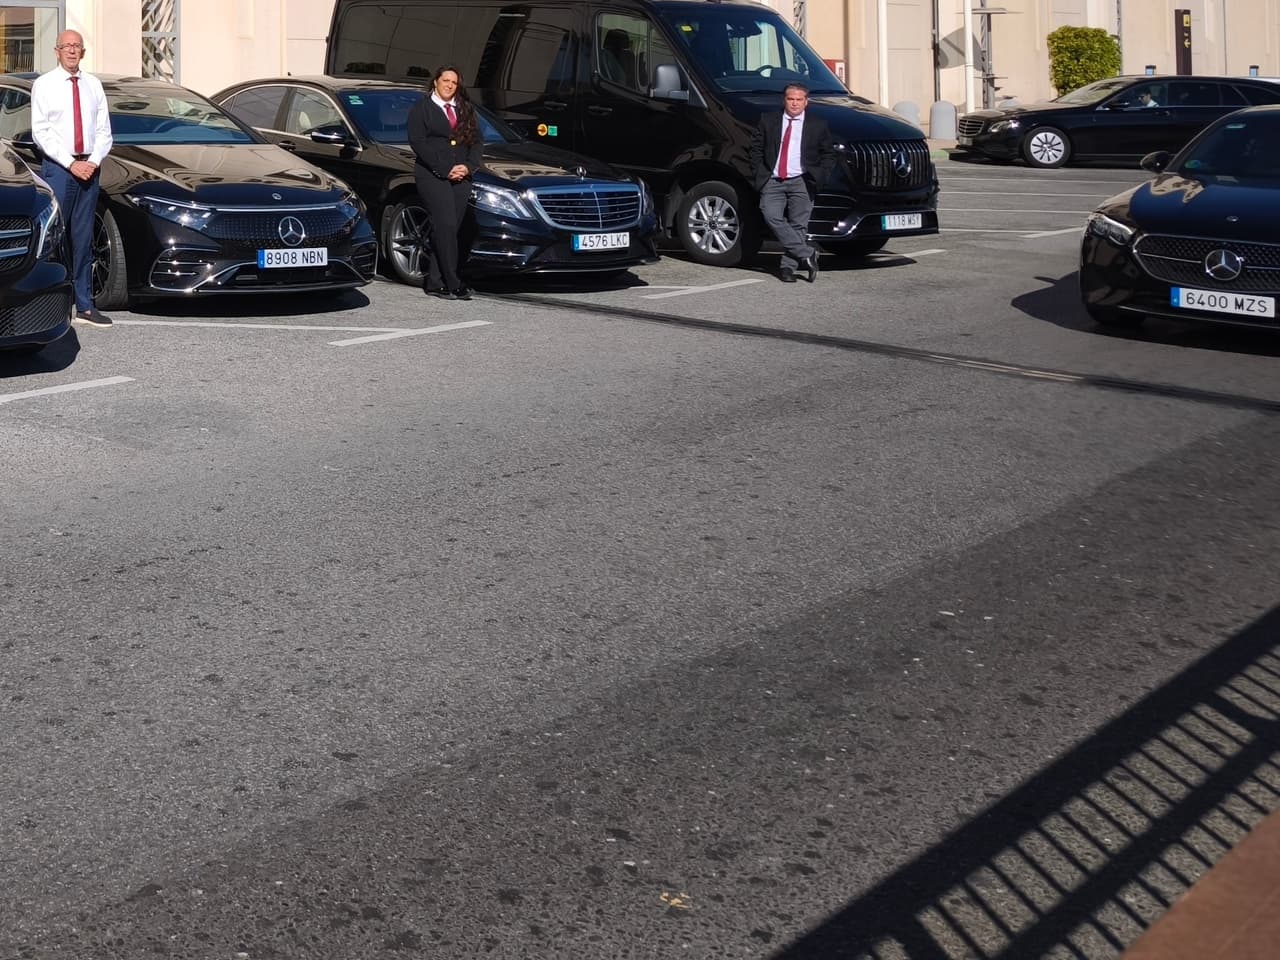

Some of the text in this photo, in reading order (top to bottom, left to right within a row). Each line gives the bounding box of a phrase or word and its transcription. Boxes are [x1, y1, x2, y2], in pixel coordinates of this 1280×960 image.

[582, 233, 628, 248] 4576 LKC
[266, 250, 324, 265] 8908 NBN
[1186, 292, 1268, 313] 6400 MZS
